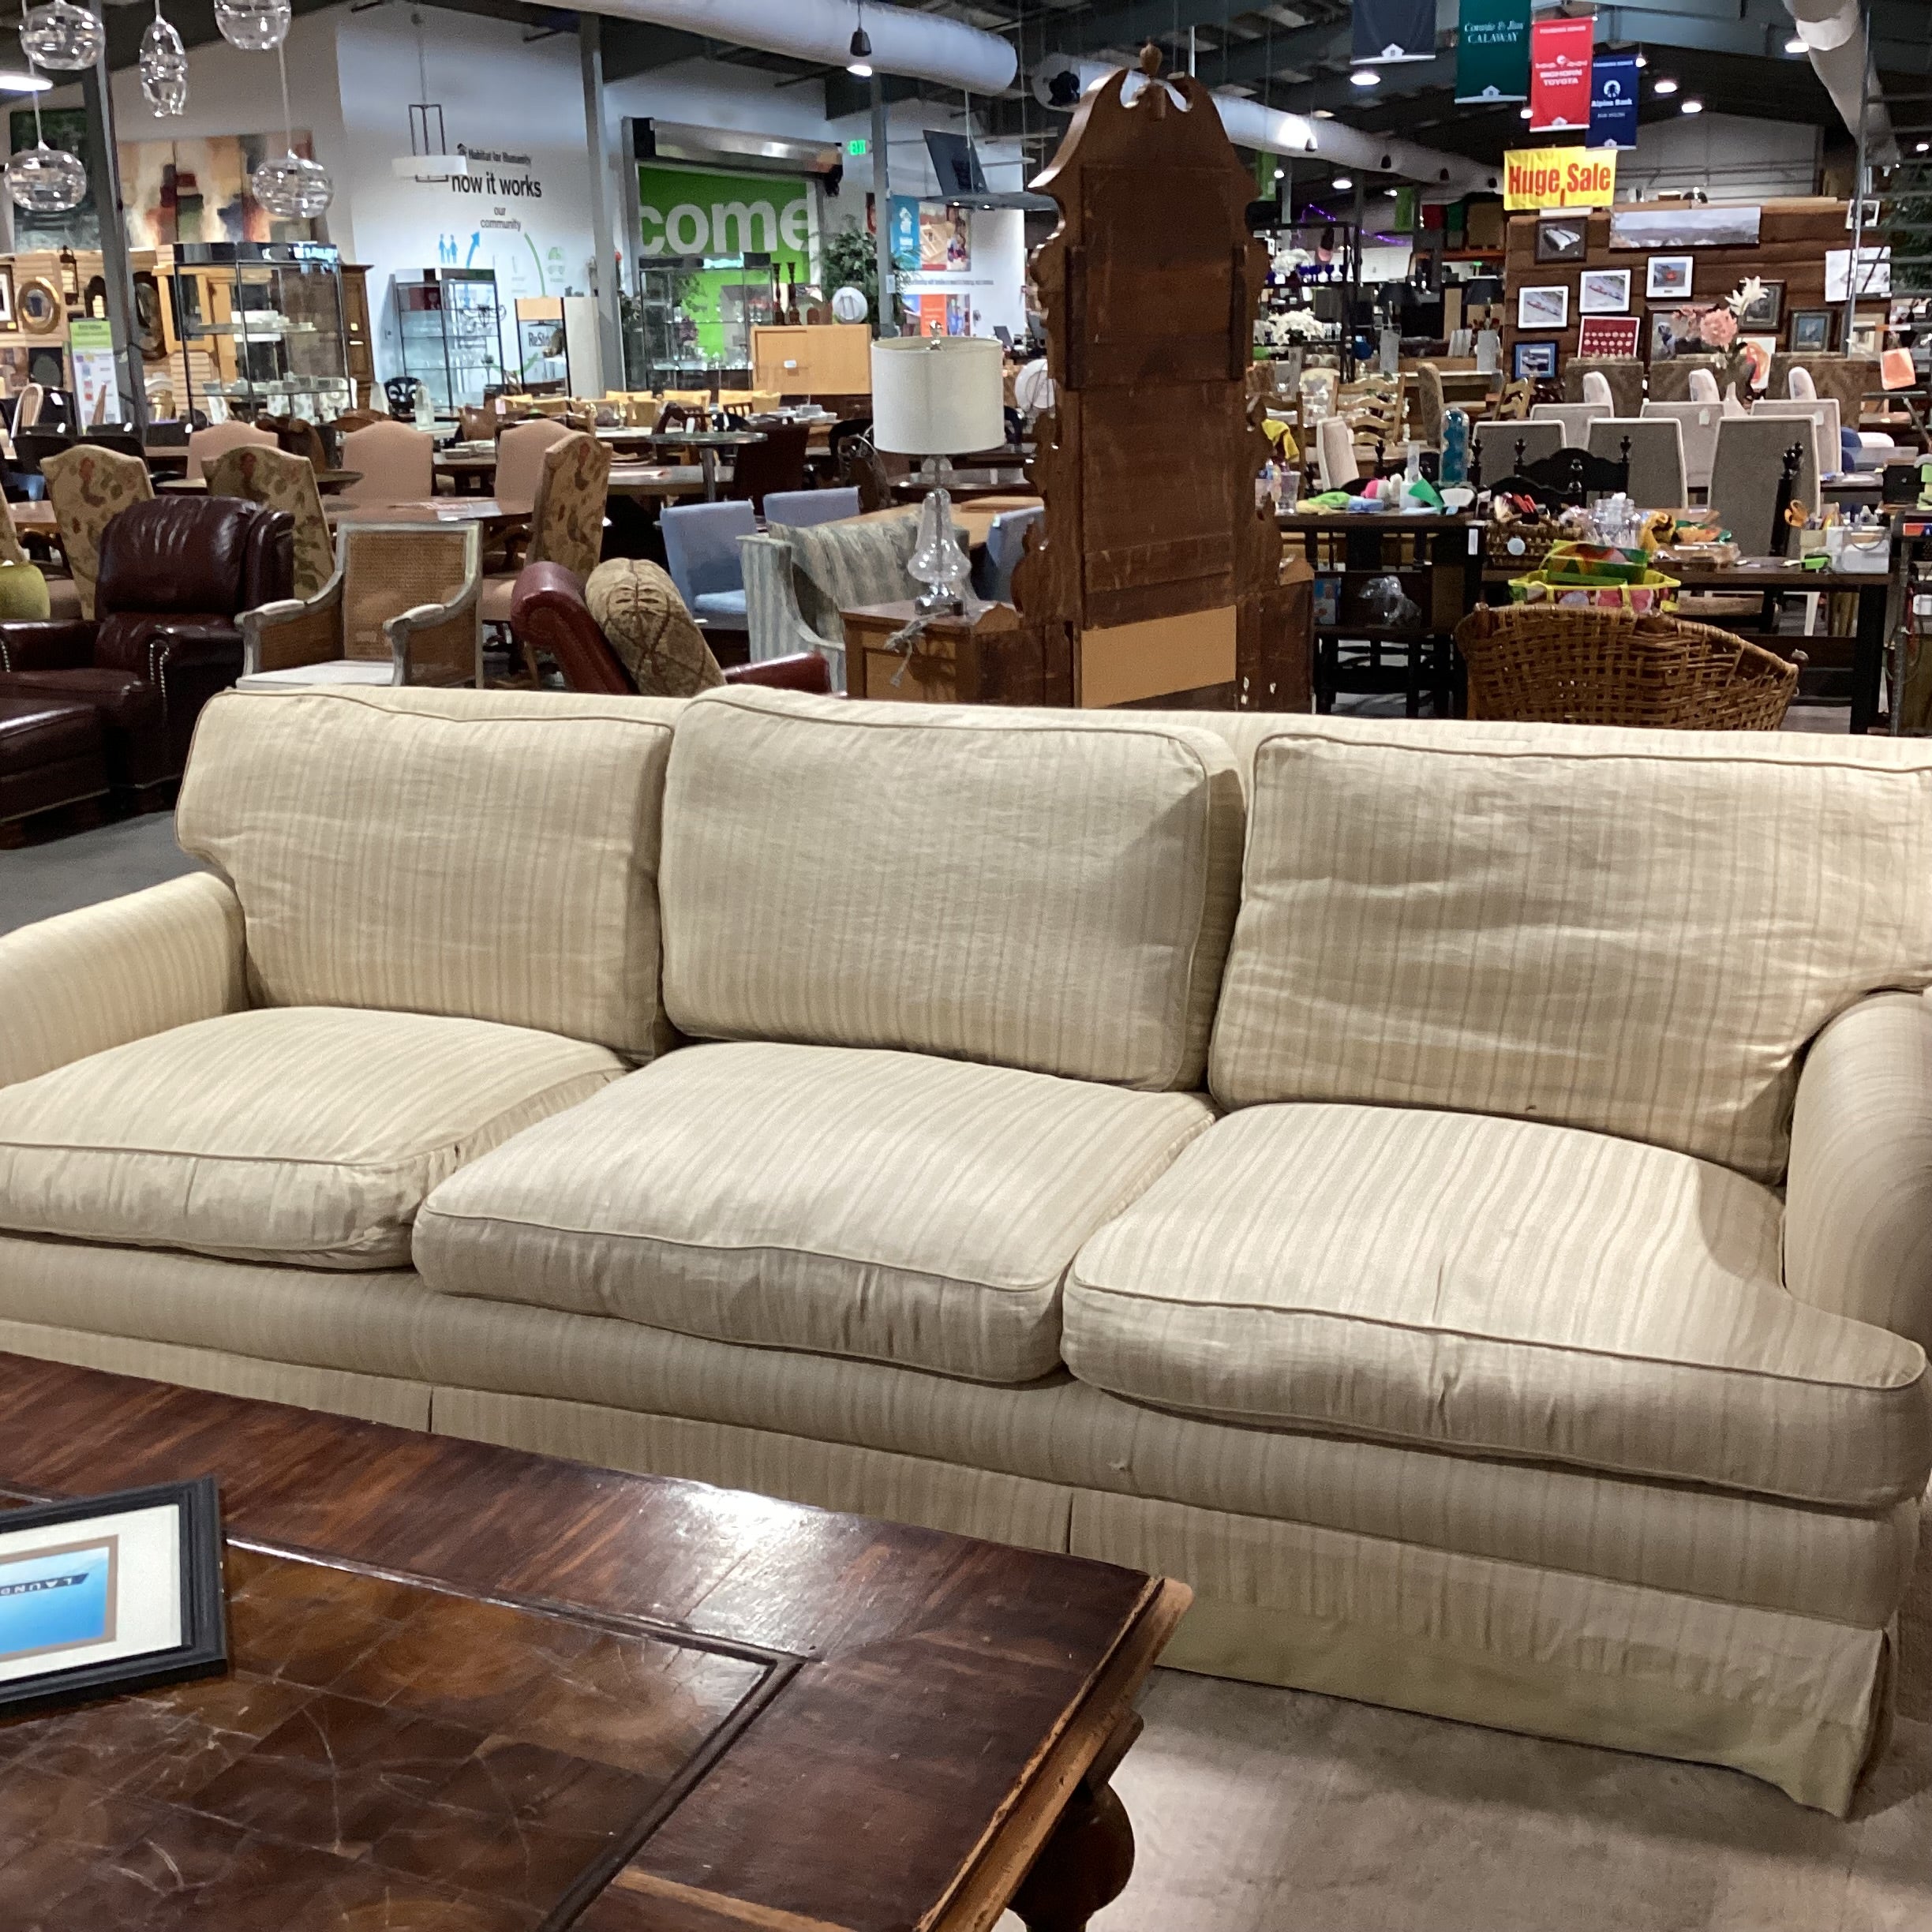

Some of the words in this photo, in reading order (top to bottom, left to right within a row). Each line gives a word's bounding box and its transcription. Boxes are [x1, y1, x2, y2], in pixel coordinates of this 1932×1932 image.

[1467, 32, 1518, 43] CALAWAY
[1540, 69, 1582, 78] BIGHORN
[1543, 77, 1579, 86] TOYOTA
[1591, 99, 1614, 108] Alpine
[850, 139, 866, 155] EXIT
[486, 171, 496, 195] it
[500, 174, 542, 198] works
[1508, 165, 1560, 197] Huge
[1567, 163, 1611, 193] Sale
[494, 207, 506, 215] our
[480, 218, 521, 232] community
[638, 198, 808, 255] come
